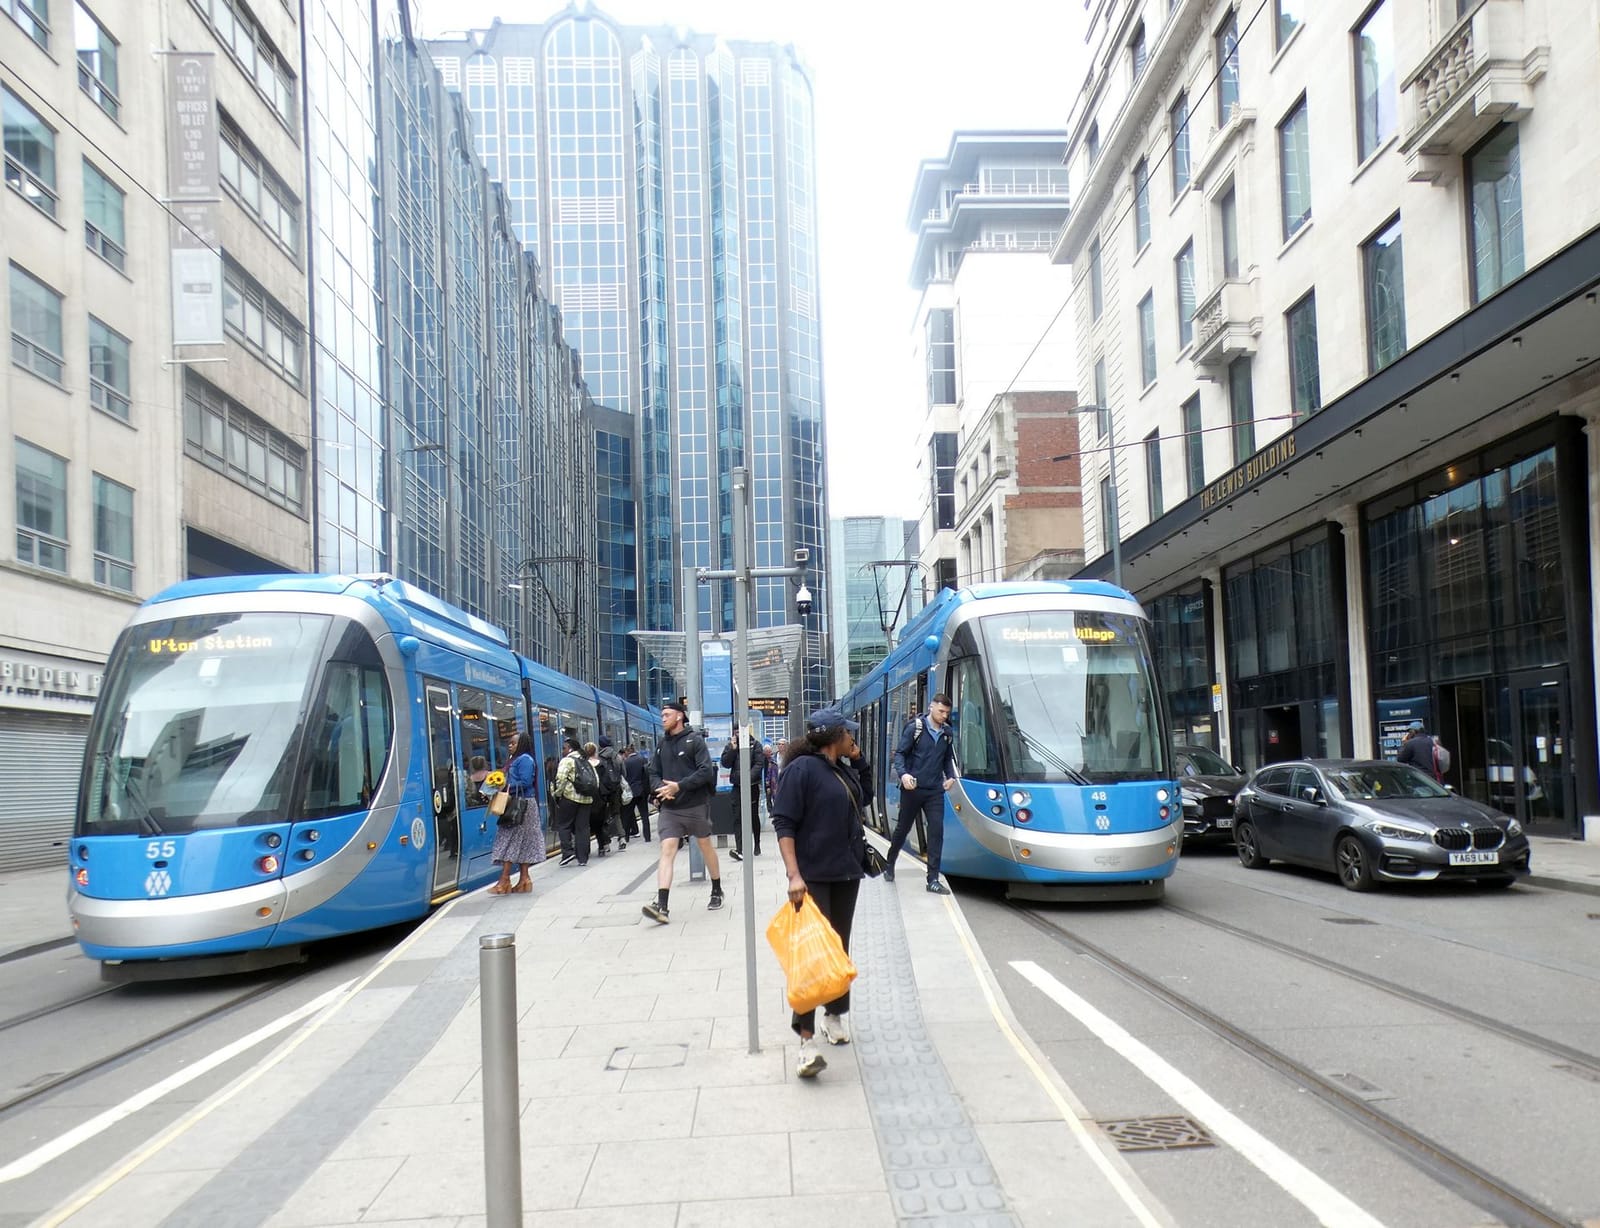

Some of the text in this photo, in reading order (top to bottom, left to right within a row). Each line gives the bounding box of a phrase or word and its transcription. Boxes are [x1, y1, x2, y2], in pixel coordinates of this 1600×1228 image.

[176, 100, 208, 113] OFFICES
[180, 114, 206, 126] TO LET
[1199, 434, 1297, 511] THE LEWIS BUILDING
[1001, 627, 1116, 642] Edgbaston Village
[203, 635, 273, 650] Station
[1090, 791, 1108, 801] 48
[144, 840, 176, 859] 55
[1454, 852, 1495, 863] YA69 LNJ
